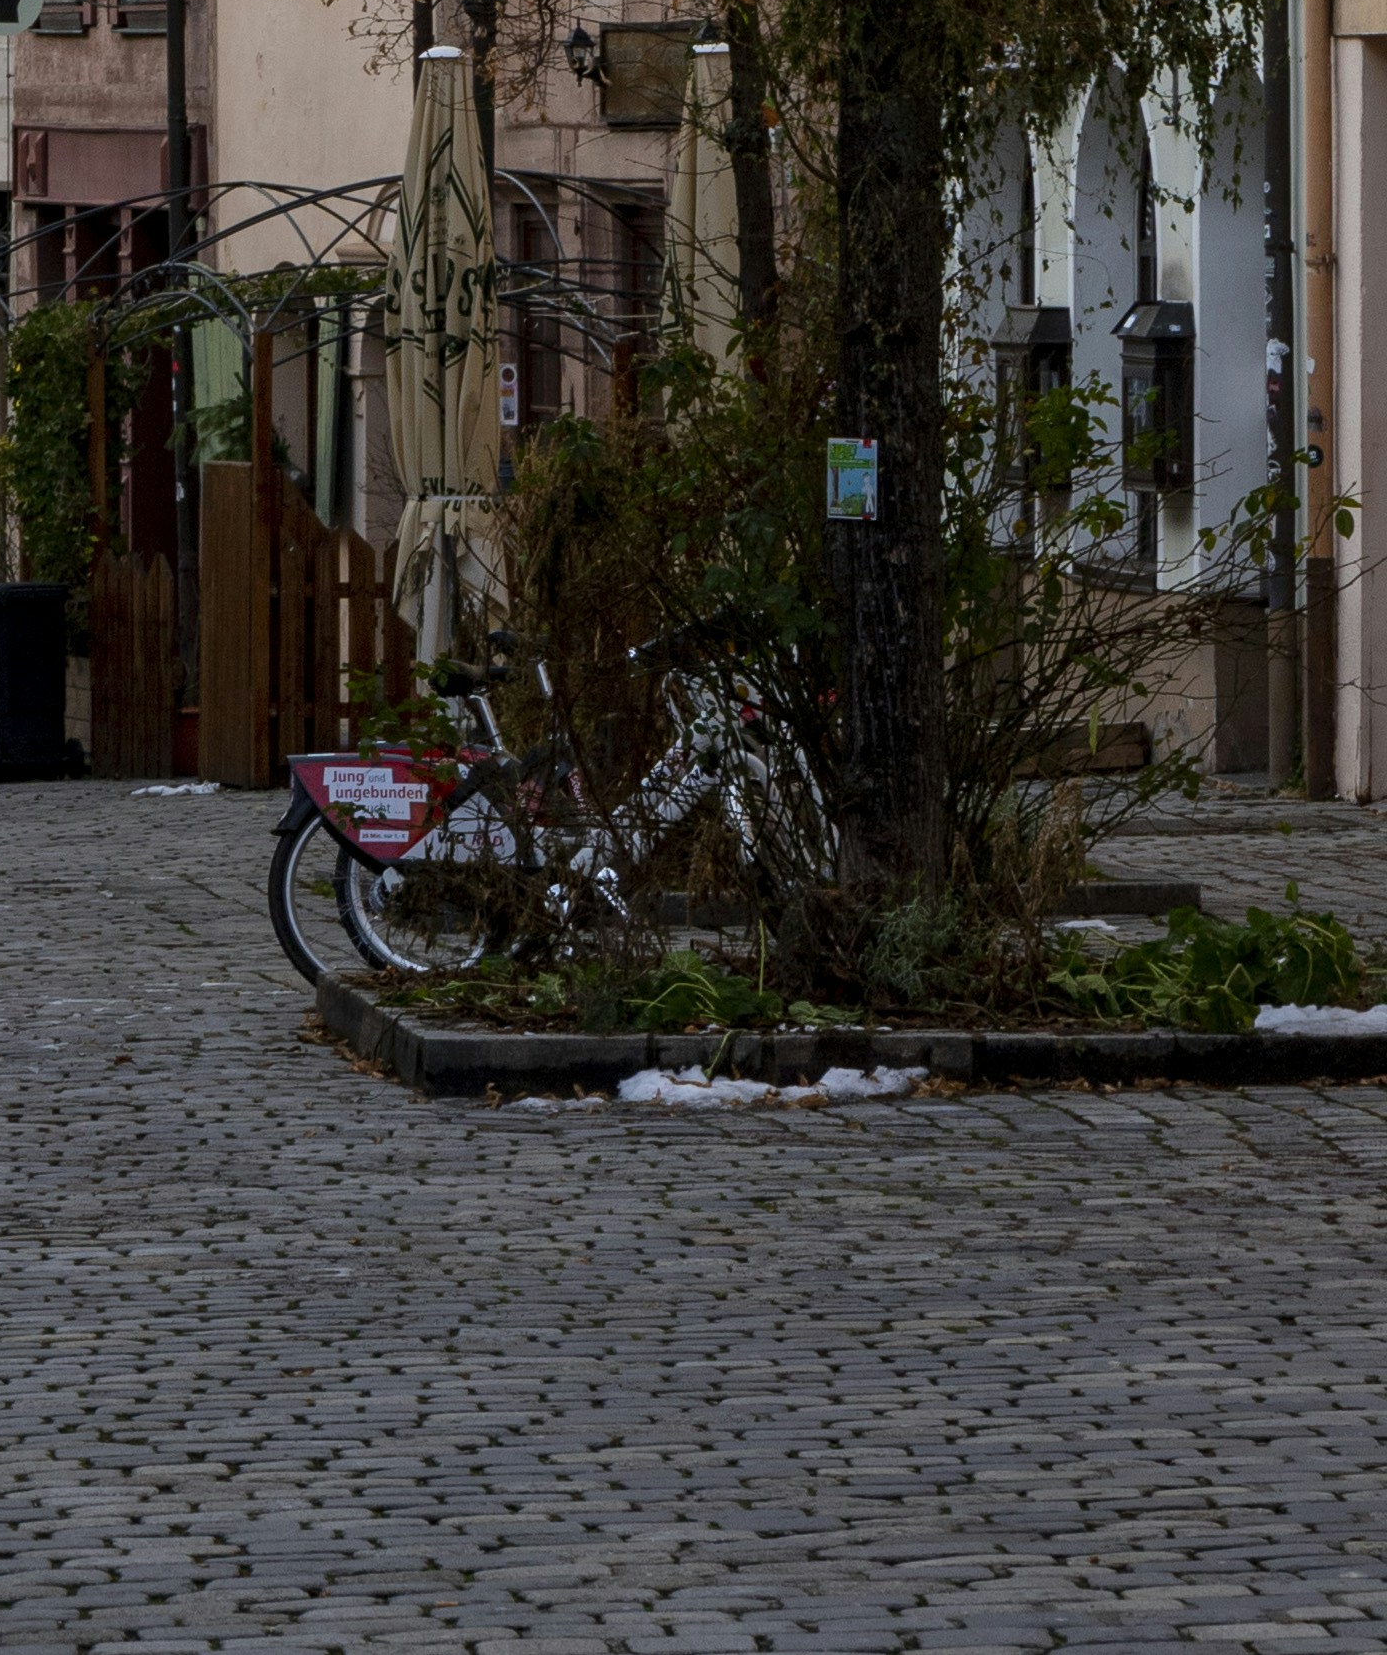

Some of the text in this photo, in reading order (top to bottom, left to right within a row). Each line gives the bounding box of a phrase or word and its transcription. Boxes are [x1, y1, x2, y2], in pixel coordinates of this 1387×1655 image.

[332, 771, 386, 785] Jung und
[336, 786, 423, 802] ungebunden
